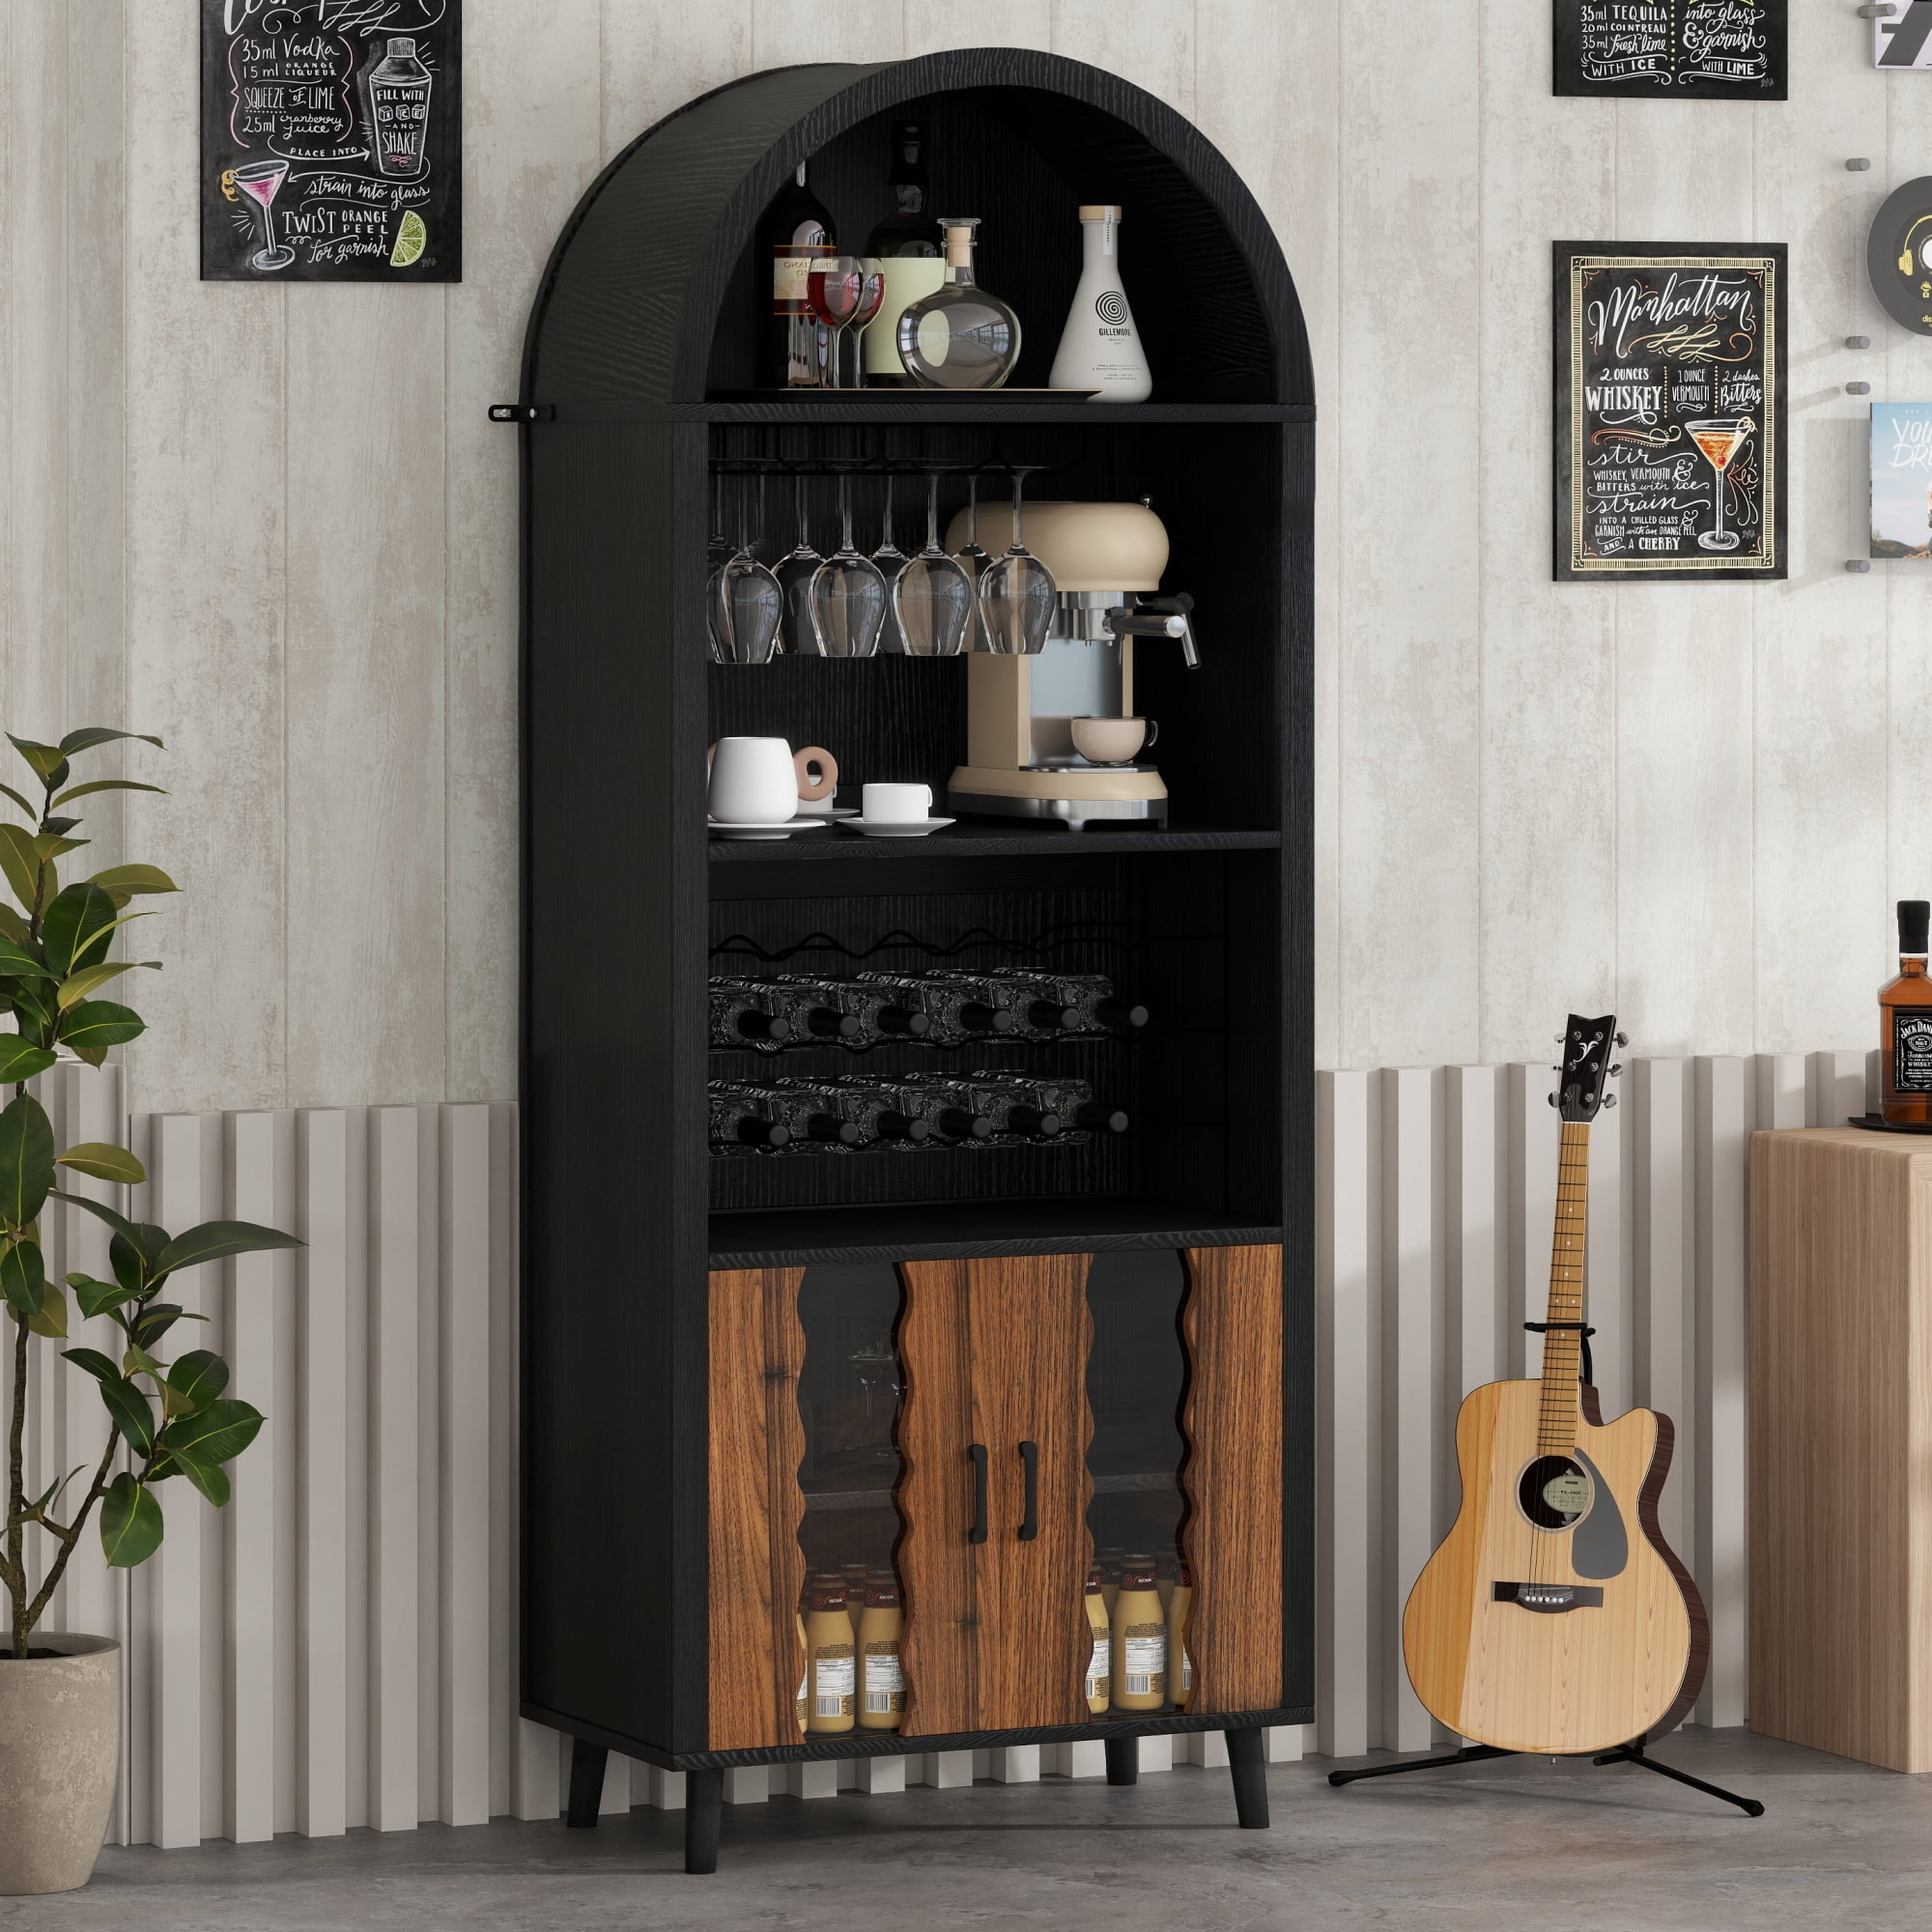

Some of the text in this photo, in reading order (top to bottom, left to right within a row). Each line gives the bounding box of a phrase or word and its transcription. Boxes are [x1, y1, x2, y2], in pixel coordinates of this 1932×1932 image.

[1611, 5, 1667, 23] TEQUILA
[1682, 1, 1766, 34] into glass
[1610, 22, 1666, 34] COINTREAU
[1604, 34, 1639, 58] fresh
[1639, 34, 1667, 54] lime
[1682, 21, 1766, 63] & garnish
[1591, 58, 1657, 77] WITH ICE
[1702, 60, 1754, 75] WITH LIME
[244, 87, 285, 109] SQUEEZE
[308, 87, 335, 110] LIME
[376, 89, 424, 101] FILL WITH
[279, 114, 344, 131] cranberry
[283, 123, 329, 140] juice
[290, 147, 357, 157] PLACE INTO
[382, 131, 418, 155] SHAKE
[304, 176, 431, 211] strain into glass
[282, 207, 388, 234] TWIST ORANGE
[343, 224, 389, 234] PEEL
[307, 239, 334, 264] for
[334, 235, 389, 264] garnish
[1587, 271, 1753, 358] Manhattan
[1599, 367, 1650, 381] 2 OUNCES
[1678, 368, 1706, 383] 1 OUNCE
[1721, 369, 1760, 382] 2 dashes
[1585, 385, 1663, 419] WHISKEY
[1671, 384, 1710, 402] VERMOUTH
[1720, 383, 1763, 406] Bitters
[1631, 468, 1671, 480] VERMOUTH
[1672, 459, 1693, 481] &
[1597, 481, 1710, 492] BITTERS with ice
[1585, 492, 1711, 514] strain
[1599, 510, 1698, 527] INTO A CHILLED GLASS &
[1595, 525, 1625, 537] GARNISH
[1659, 526, 1682, 536] ORANGE
[1683, 526, 1697, 536] PEEL
[1604, 536, 1681, 552] AND A CHERRY
